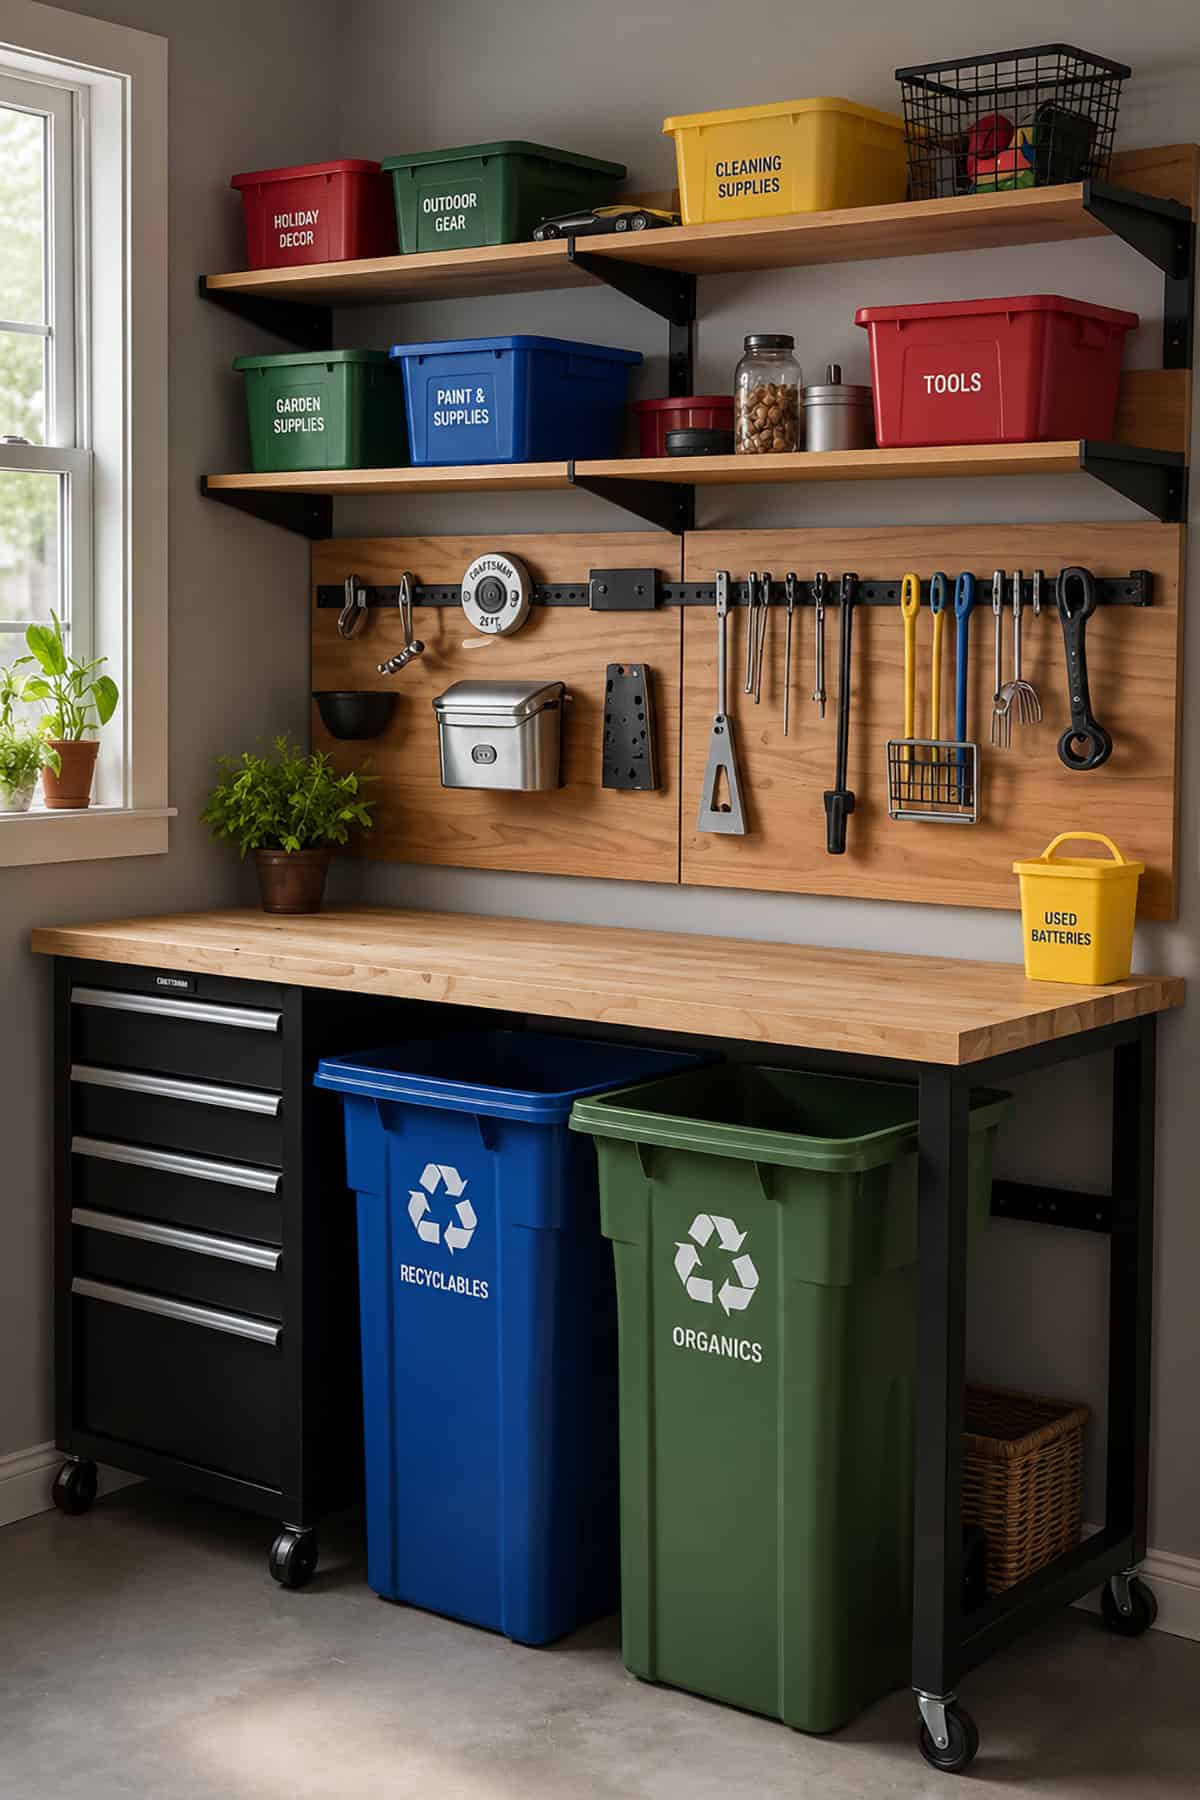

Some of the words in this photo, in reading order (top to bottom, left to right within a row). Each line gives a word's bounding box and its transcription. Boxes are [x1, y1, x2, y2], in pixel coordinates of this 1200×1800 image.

[715, 155, 782, 178] CLEANING
[718, 176, 780, 199] SUPPLIES
[423, 192, 477, 214] OUTDOOR
[274, 209, 320, 229] HOLIDAY
[435, 214, 466, 232] GEAR
[279, 230, 314, 249] DECOR
[923, 372, 982, 394] TOOLS
[276, 396, 321, 414] GARDEN
[437, 388, 473, 405] PAINT
[475, 387, 485, 404] &
[273, 416, 325, 434] SUPPLIES
[433, 408, 489, 427] SUPPLIES
[1044, 911, 1078, 927] USED
[1031, 928, 1092, 946] BATTERIES
[400, 1263, 489, 1299] RECYCLABLES
[672, 1326, 762, 1363] ORGANICS
